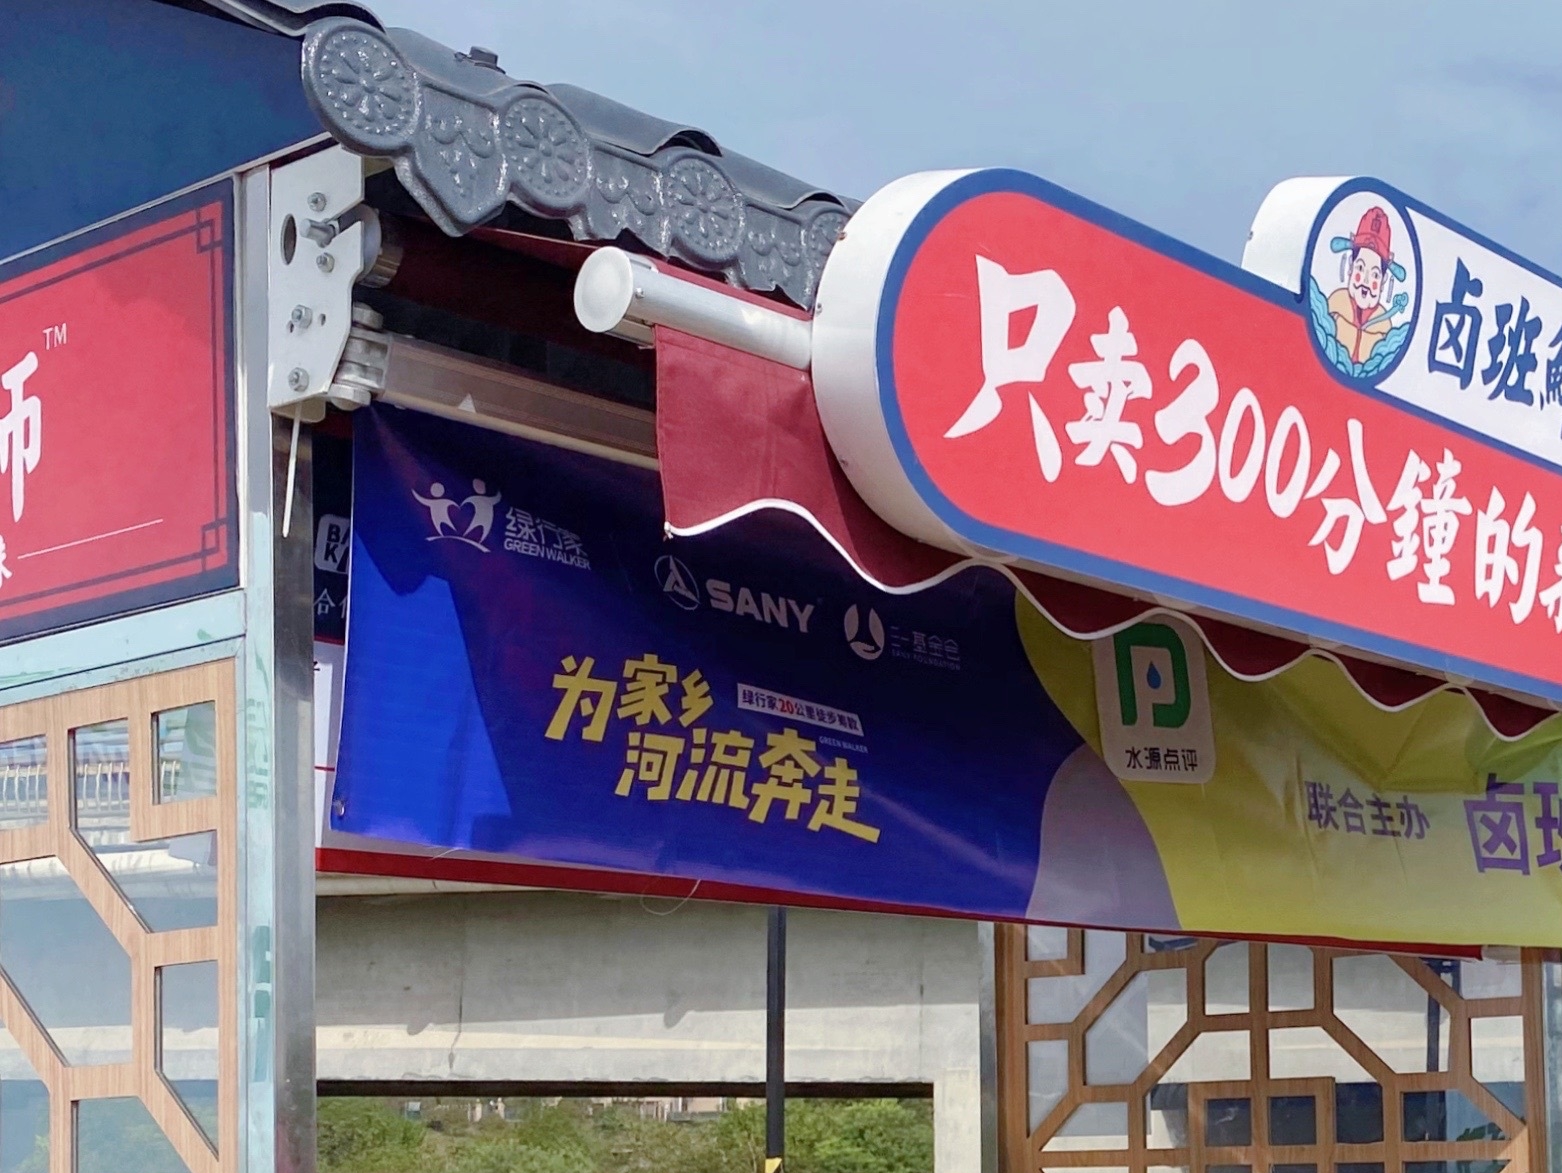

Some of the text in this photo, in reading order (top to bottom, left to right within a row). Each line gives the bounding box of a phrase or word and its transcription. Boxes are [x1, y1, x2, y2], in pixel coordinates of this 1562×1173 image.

[43, 323, 67, 350] TM
[504, 538, 591, 570] GREEN WALKER
[505, 506, 589, 557] 绿行家
[313, 587, 348, 619] 合
[706, 578, 815, 634] SANY
[544, 654, 715, 743] 为家乡
[614, 727, 881, 843] 河流奔走
[1125, 746, 1199, 773] 水源点评
[1305, 780, 1430, 842] 联合主办
